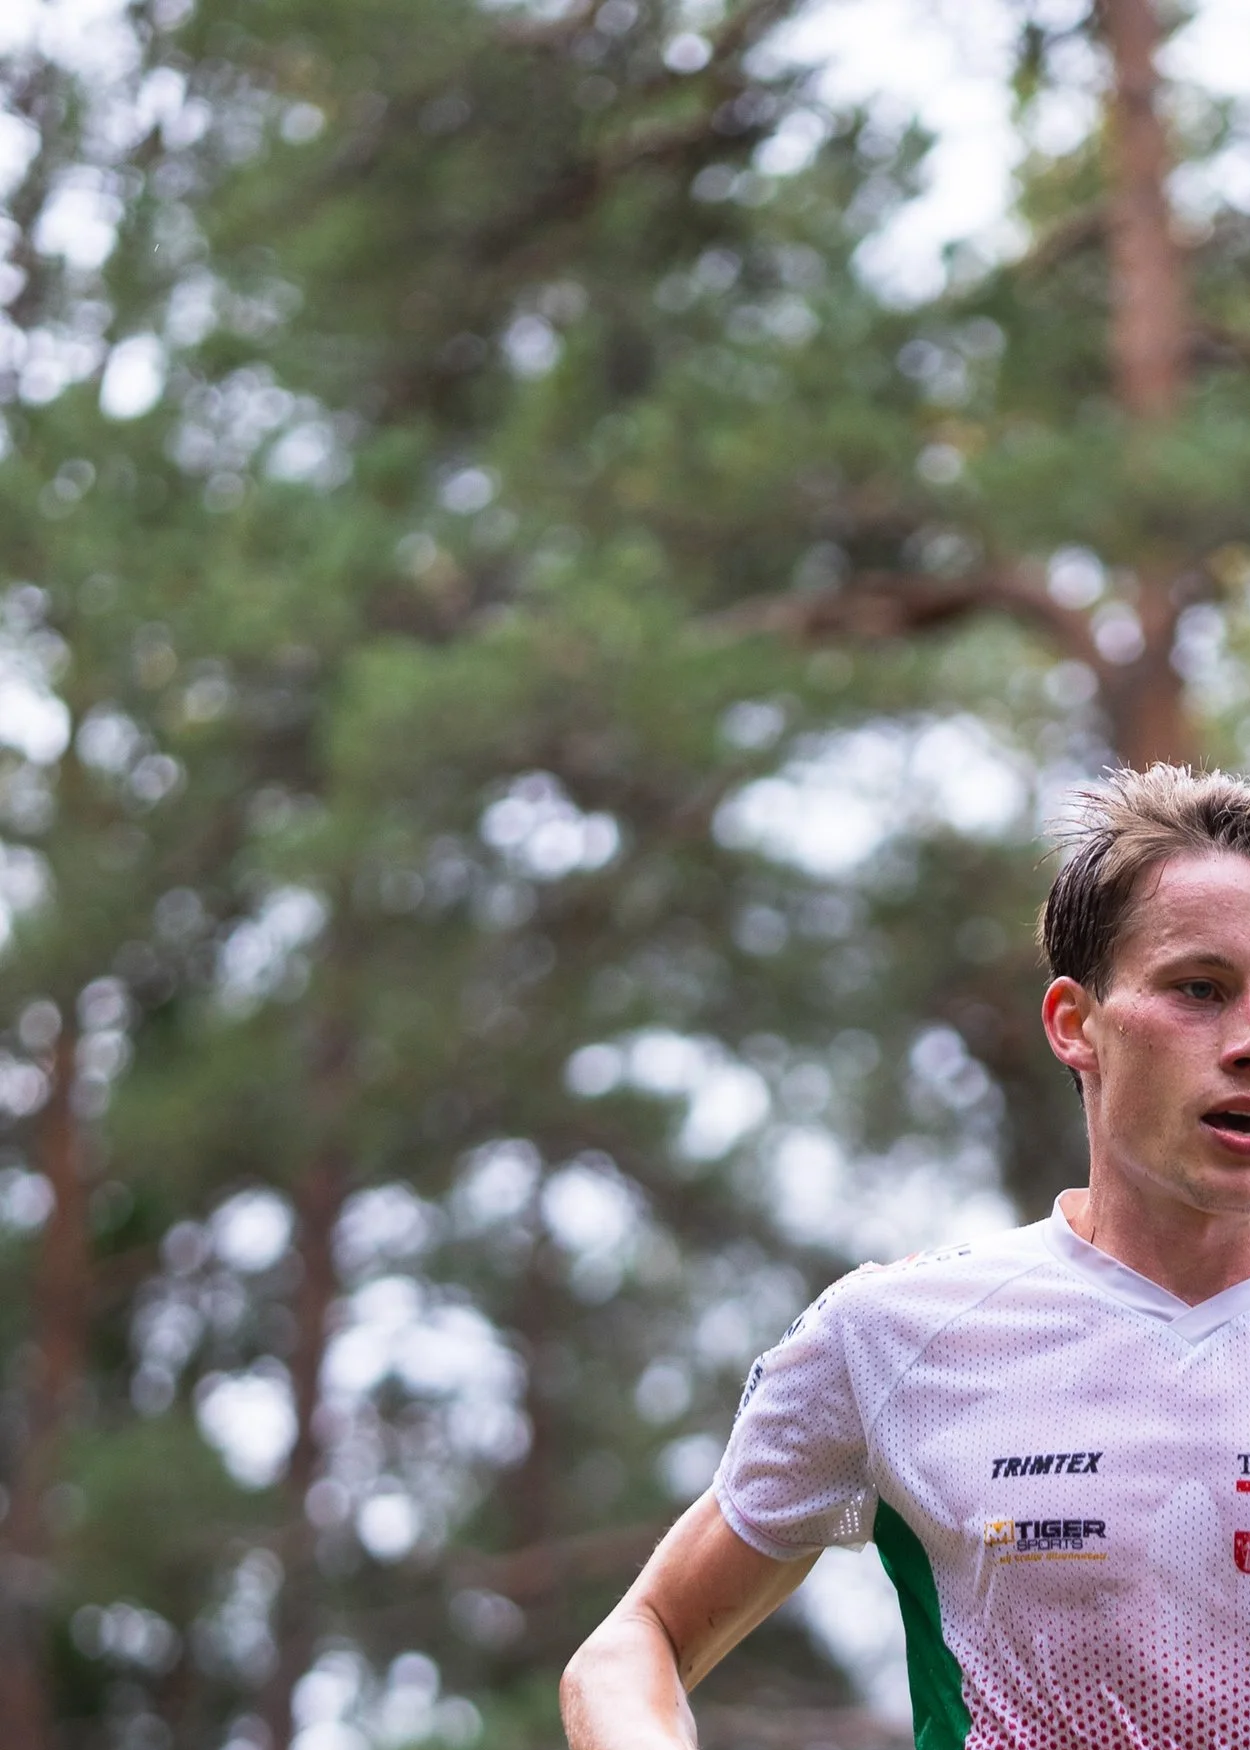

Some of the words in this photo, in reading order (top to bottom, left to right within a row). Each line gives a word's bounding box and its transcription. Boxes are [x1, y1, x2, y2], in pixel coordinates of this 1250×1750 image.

[991, 1452, 1103, 1480] TRIMTEX
[1015, 1520, 1106, 1539] TIGER
[1017, 1539, 1083, 1551] SPORTS
